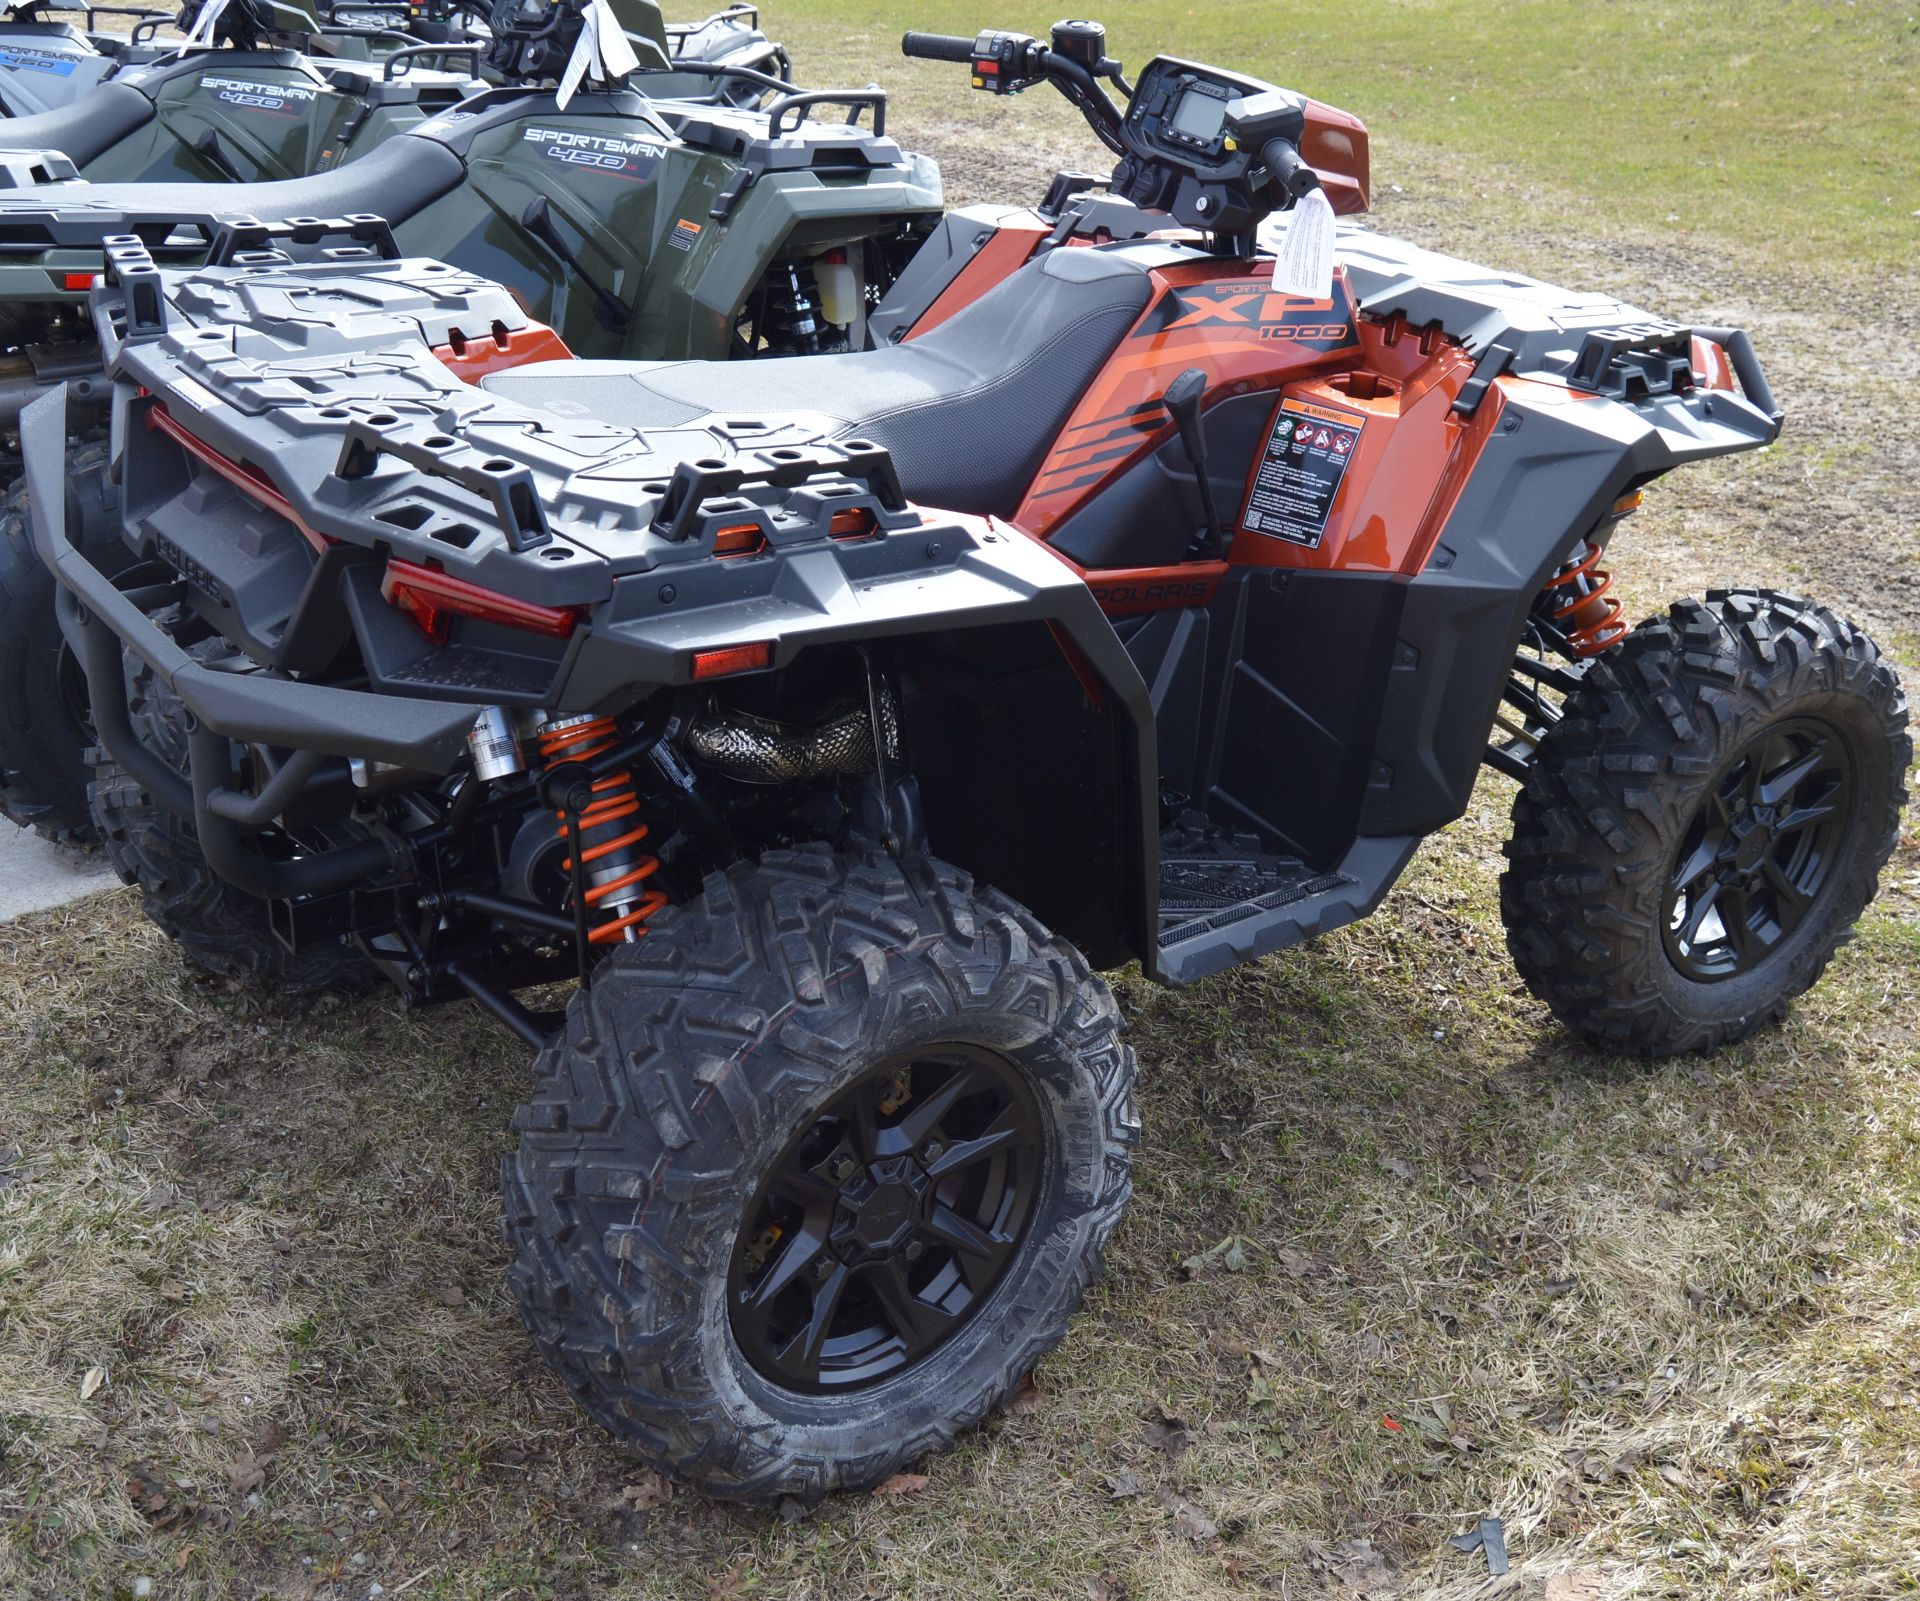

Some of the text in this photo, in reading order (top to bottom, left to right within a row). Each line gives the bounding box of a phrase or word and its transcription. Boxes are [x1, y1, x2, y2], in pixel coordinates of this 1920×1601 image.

[0, 45, 84, 63] PORTSMAN
[4, 56, 55, 68] 450
[200, 77, 317, 101] SPORTSMAN
[219, 91, 284, 109] 450
[523, 128, 668, 159] SPORTSMAN
[547, 146, 627, 170] 450
[1215, 284, 1273, 294] SPORTSM
[1163, 294, 1335, 330] XP
[1258, 324, 1348, 341] 1000
[1311, 407, 1342, 420] WARNING
[1091, 582, 1209, 603] POLARIS
